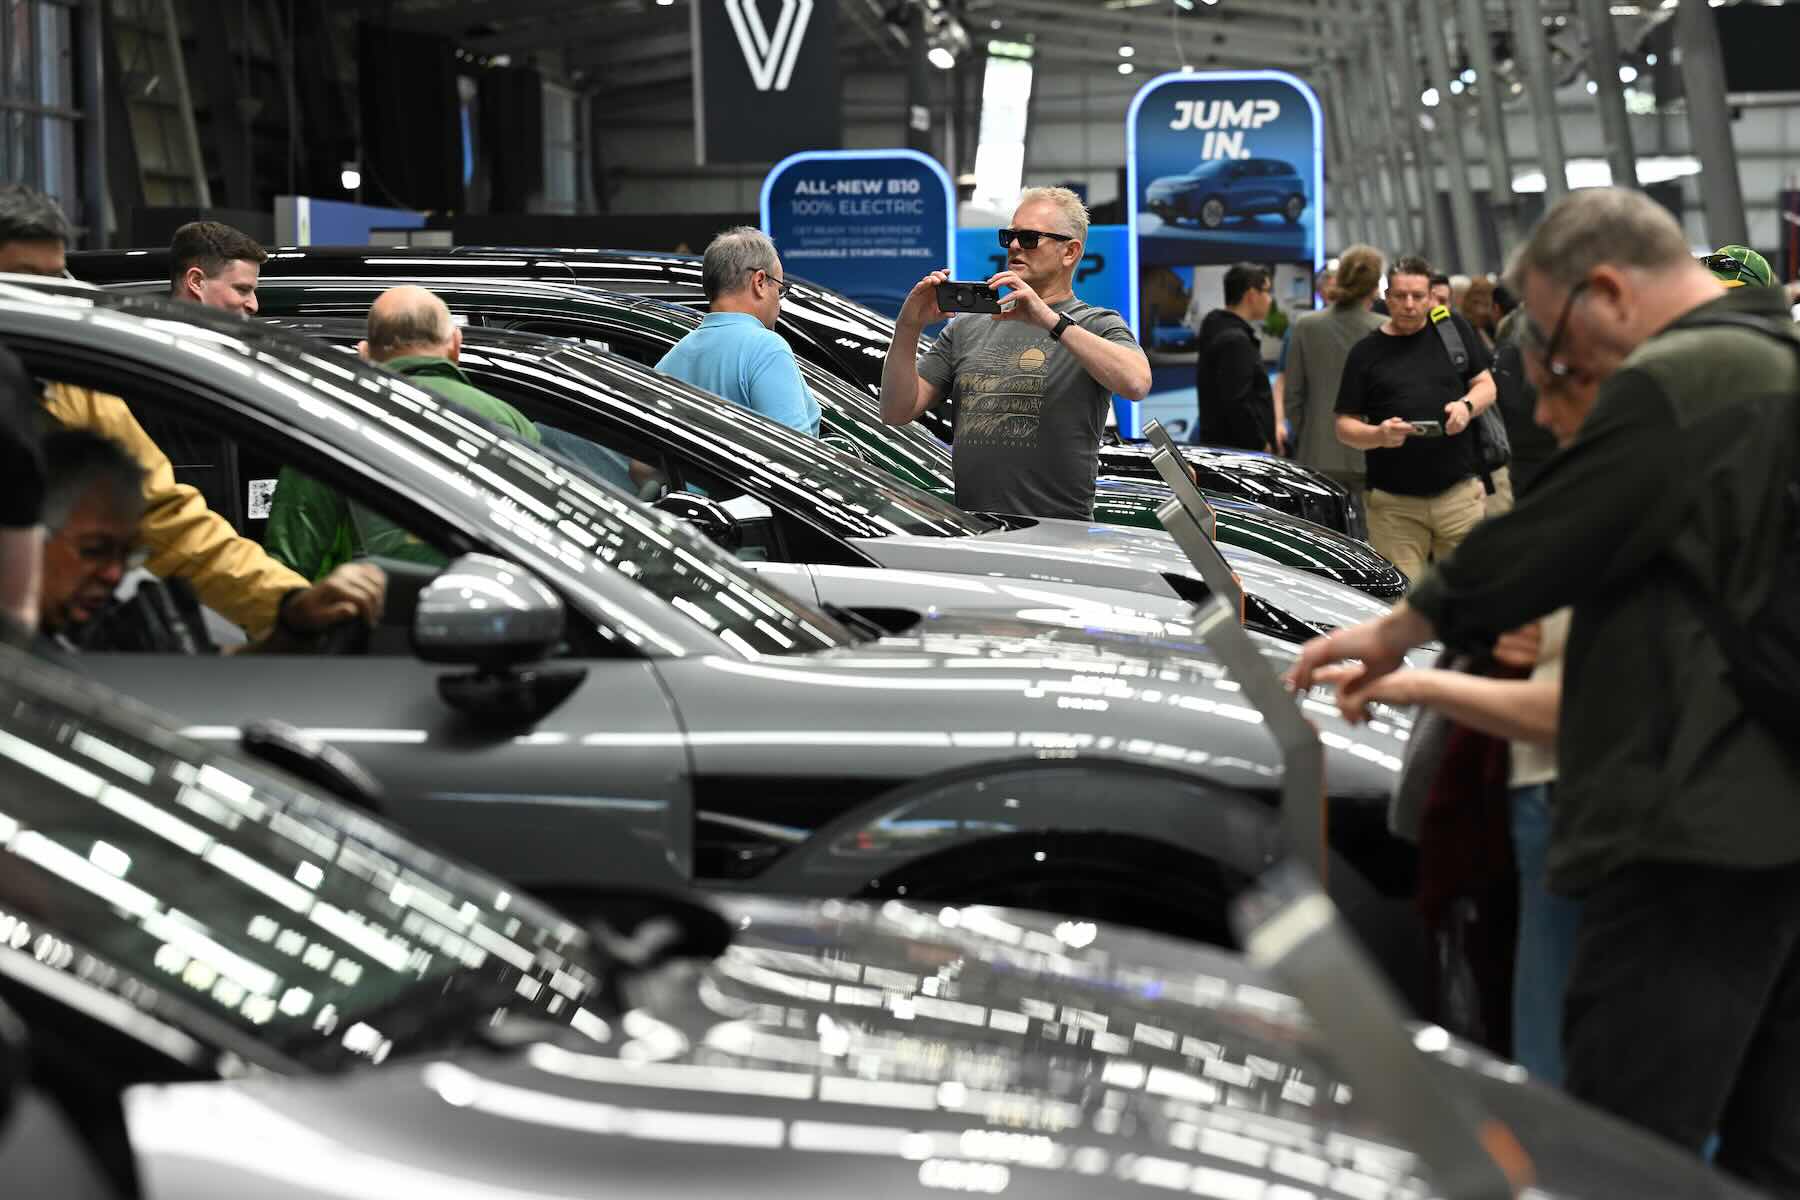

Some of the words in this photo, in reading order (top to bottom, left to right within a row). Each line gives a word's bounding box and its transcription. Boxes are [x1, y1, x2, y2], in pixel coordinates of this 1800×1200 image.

[1169, 99, 1280, 130] JUMP
[1201, 130, 1251, 160] IN.
[795, 180, 883, 195] ALL-NEW
[887, 179, 921, 194] B10
[791, 200, 836, 215] 100%
[839, 199, 925, 215] ELECTRIC
